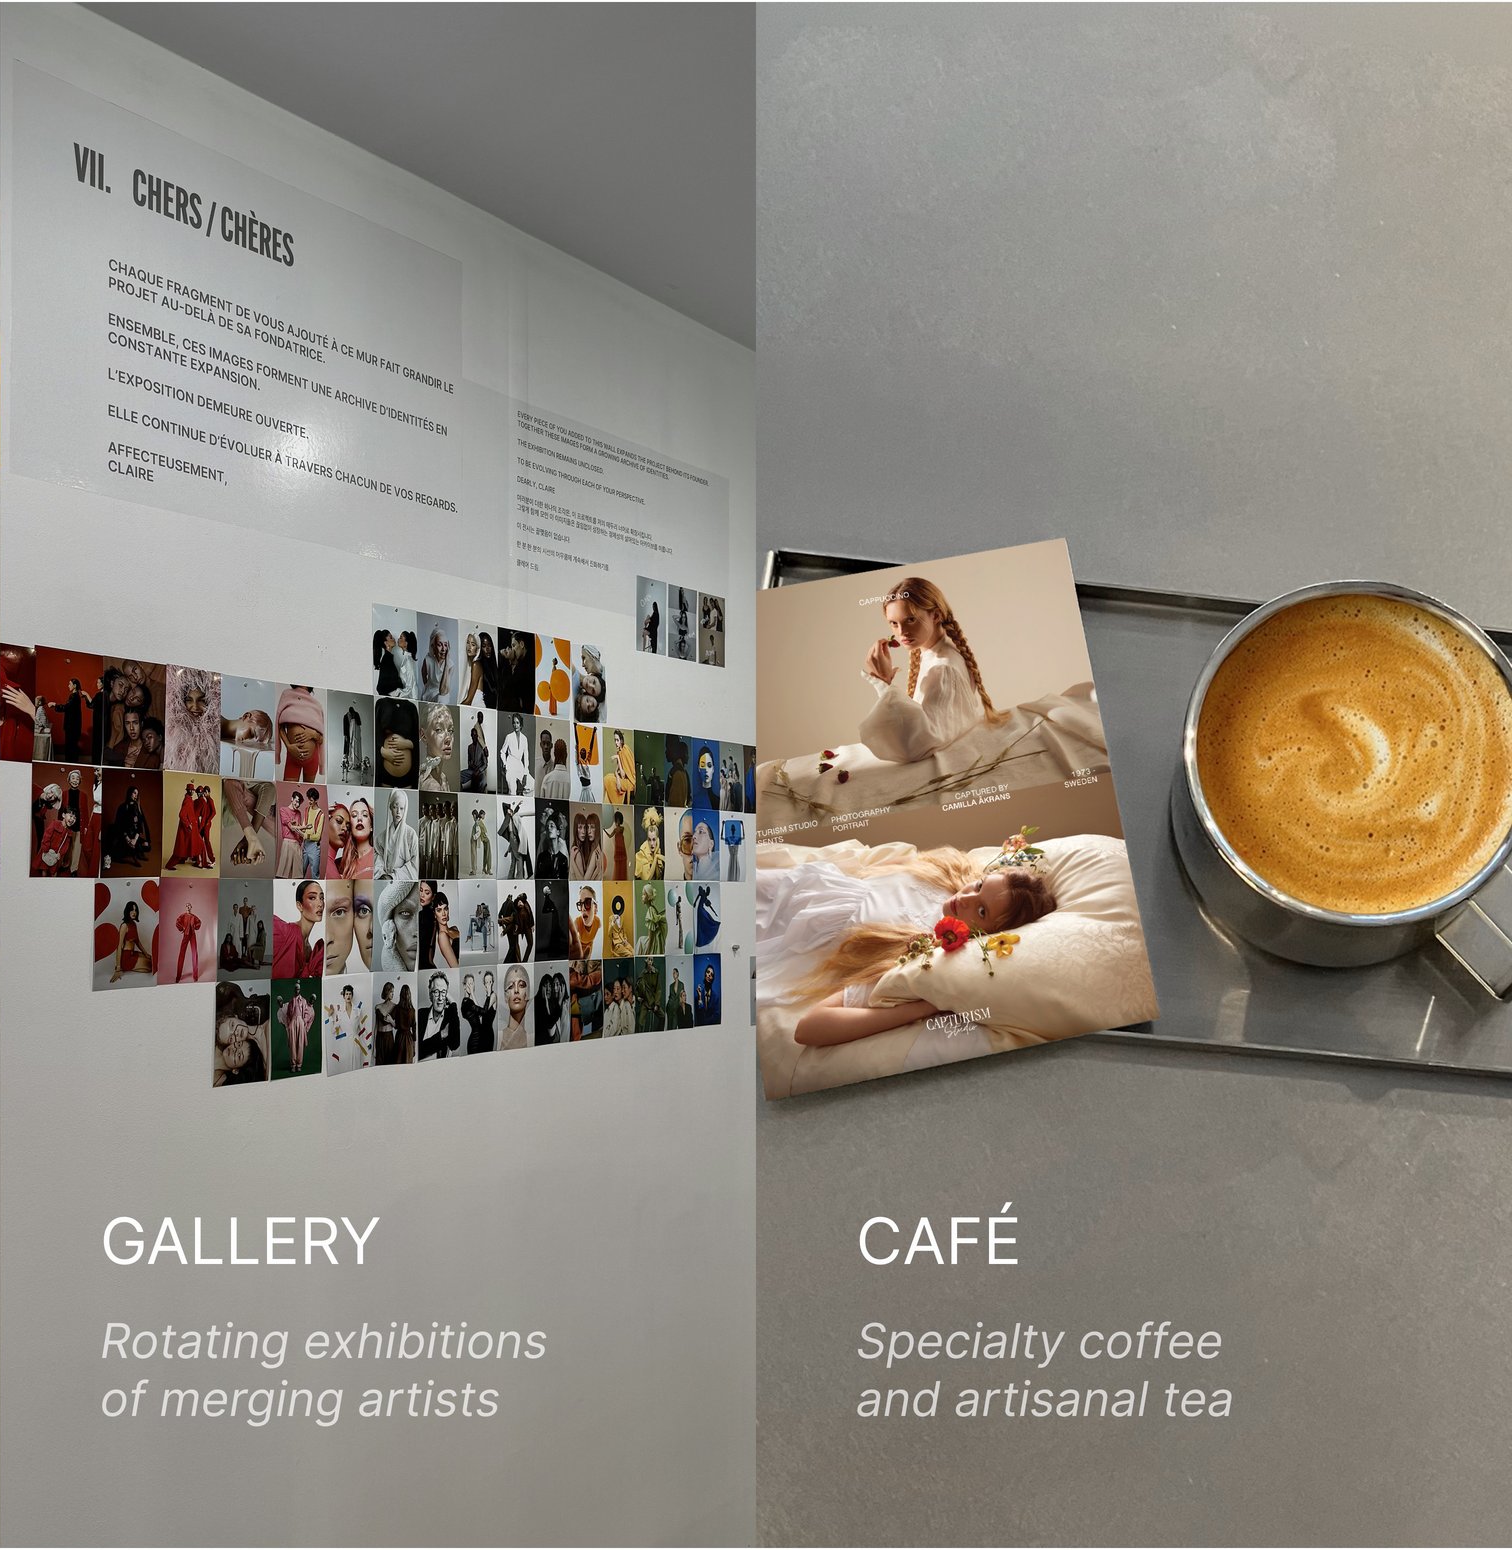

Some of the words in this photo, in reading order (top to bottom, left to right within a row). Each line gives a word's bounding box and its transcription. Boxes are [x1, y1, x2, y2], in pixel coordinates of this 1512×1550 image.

[74, 142, 111, 194] VII.
[133, 168, 202, 230] CHERS
[206, 201, 217, 237] /
[221, 206, 295, 267] CHÈRES
[108, 276, 158, 305] PROJET
[161, 295, 215, 325] AU-DELÀ
[218, 315, 234, 331] DE
[236, 322, 252, 337] SA
[254, 328, 326, 363] FONDATRICE.
[108, 258, 164, 289] CHAQUE
[166, 280, 232, 314] FRAGMENT
[236, 305, 251, 321] DE
[253, 311, 284, 333] VOUS
[287, 323, 329, 349] AJOUTÉ
[331, 337, 338, 352] À
[340, 343, 354, 358] CE
[356, 349, 378, 367] MUR
[380, 357, 400, 375] FAIT
[402, 365, 442, 390] GRANDIR
[444, 380, 454, 394] LE
[108, 331, 188, 368] CONSTANTE
[190, 357, 261, 391] EXPANSION.
[108, 312, 179, 349] ENSEMBLE,
[182, 337, 206, 357] CES
[209, 346, 254, 372] IMAGES
[256, 362, 308, 390] FORMENT
[311, 380, 332, 398] UNE
[334, 388, 378, 413] ARCHIVE
[436, 422, 448, 436] EN
[197, 394, 253, 422] DEMEURE
[255, 411, 309, 439] OUVERTE.
[517, 410, 534, 423] EVERY
[534, 416, 548, 428] PIECE
[548, 422, 556, 431] OF
[556, 425, 568, 435] YOU
[568, 429, 584, 441] ADDED
[585, 435, 592, 444] TO
[592, 438, 603, 448] THIS
[603, 442, 616, 453] WALL
[616, 447, 638, 461] EXPANDS
[517, 420, 544, 436] TOGETHER
[544, 430, 560, 442] THESE
[560, 435, 580, 449] IMAGES
[580, 442, 594, 454] FORM
[108, 404, 138, 424] ELLE
[141, 414, 206, 443] CONTINUE
[274, 450, 282, 464] À
[285, 455, 333, 478] TRAVERS
[335, 469, 378, 491] CHACUN
[380, 482, 392, 495] DE
[394, 486, 413, 501] VOS
[415, 492, 458, 514] REGARDS.
[108, 441, 228, 486] AFFECTEUSEMENT,
[517, 438, 527, 449] THE
[528, 442, 556, 458] EXHIBITION
[556, 451, 577, 466] REMAINS
[108, 460, 154, 482] CLAIRE
[517, 456, 524, 466] TO
[525, 459, 532, 468] BE
[532, 462, 558, 477] EVOLVING
[558, 470, 582, 485] THROUGH
[582, 478, 596, 489] EACH
[596, 482, 602, 491] OF
[602, 485, 616, 495] YOUR
[538, 483, 555, 494] CLAIRE
[858, 591, 910, 607] CAPPUCCINO
[1064, 775, 1098, 789] SWEDEN
[1071, 768, 1091, 779] 1973
[942, 798, 977, 812] CAMILLA
[979, 791, 1011, 807] ÅKRANS
[954, 785, 993, 801] CAPTURED
[995, 783, 1009, 793] BY
[788, 820, 818, 832] STUDIO
[830, 806, 891, 823] PHOTOGRAPHY
[832, 819, 870, 832] PORTRAIT
[926, 1006, 991, 1033] CAPTURISM
[944, 1022, 977, 1039] Studio
